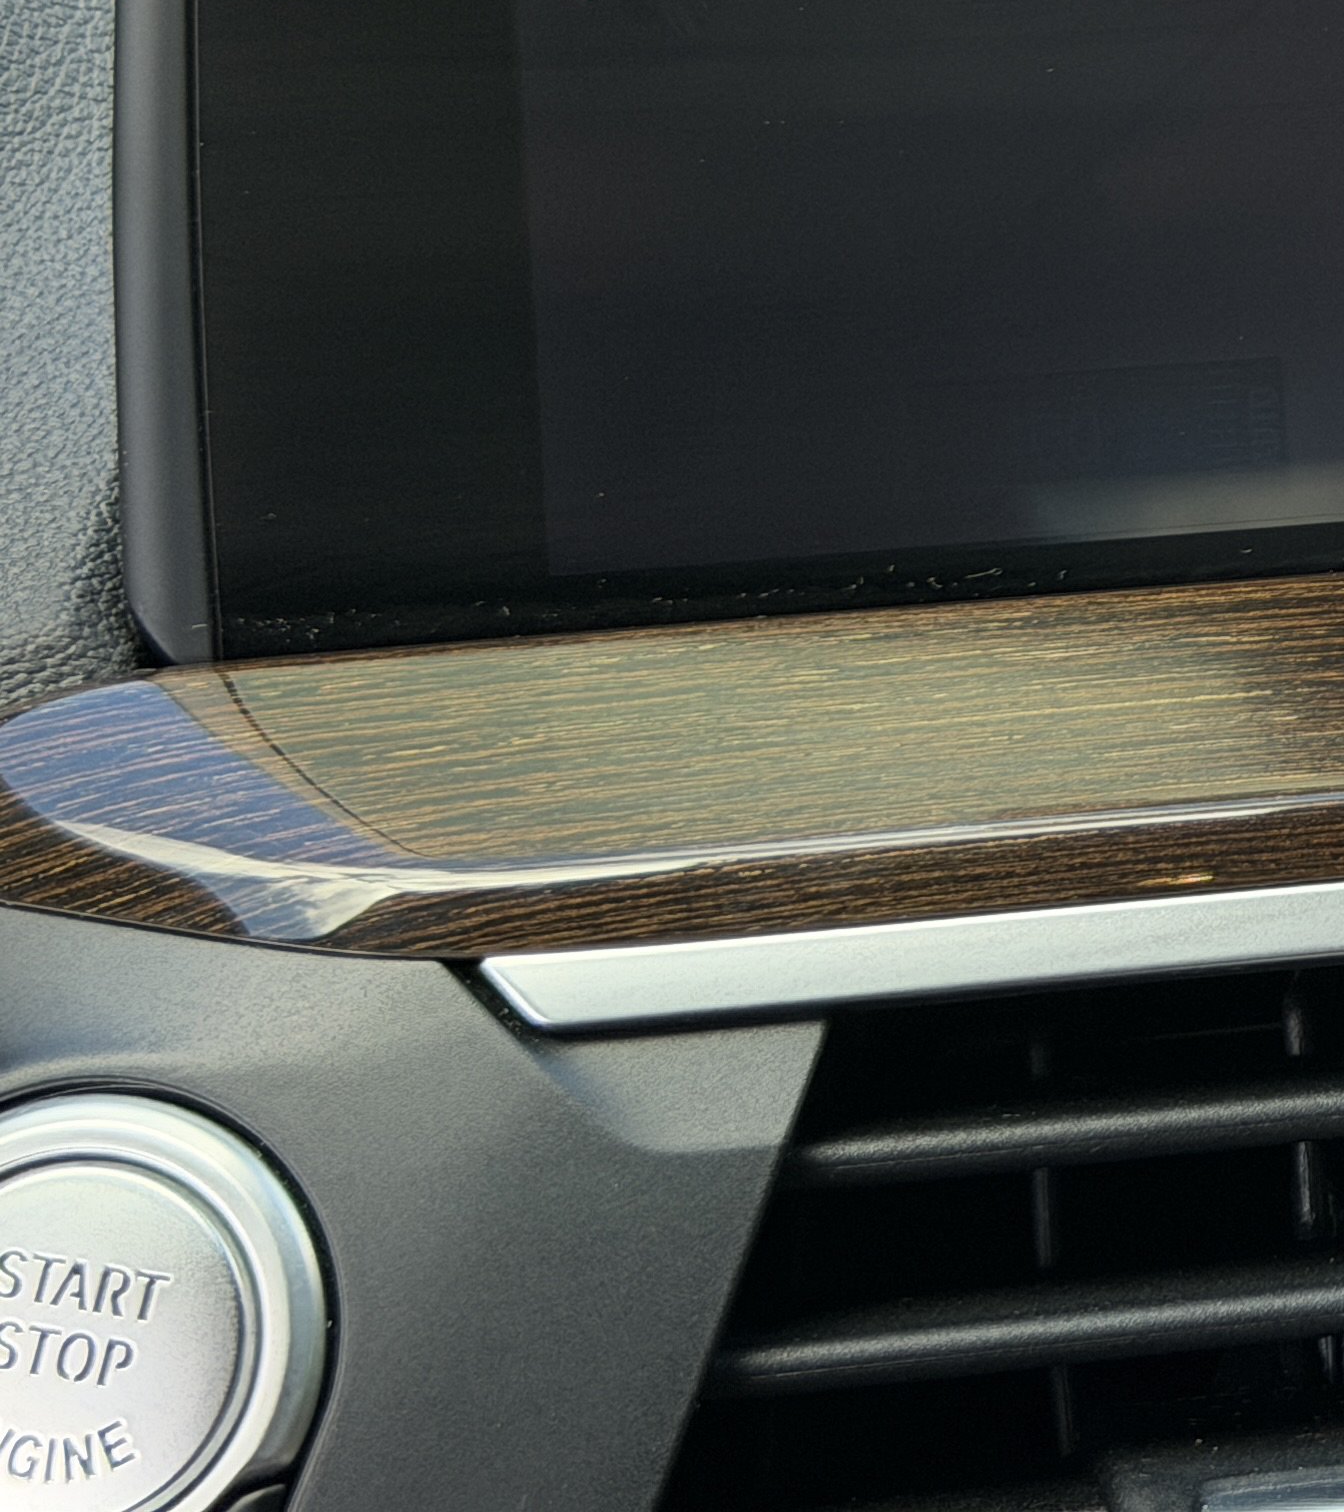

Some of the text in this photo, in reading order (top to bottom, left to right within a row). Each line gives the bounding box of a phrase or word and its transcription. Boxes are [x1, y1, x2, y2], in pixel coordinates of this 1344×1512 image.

[0, 1249, 170, 1321] START
[0, 1321, 134, 1386] STOP
[0, 1420, 137, 1483] GINE
